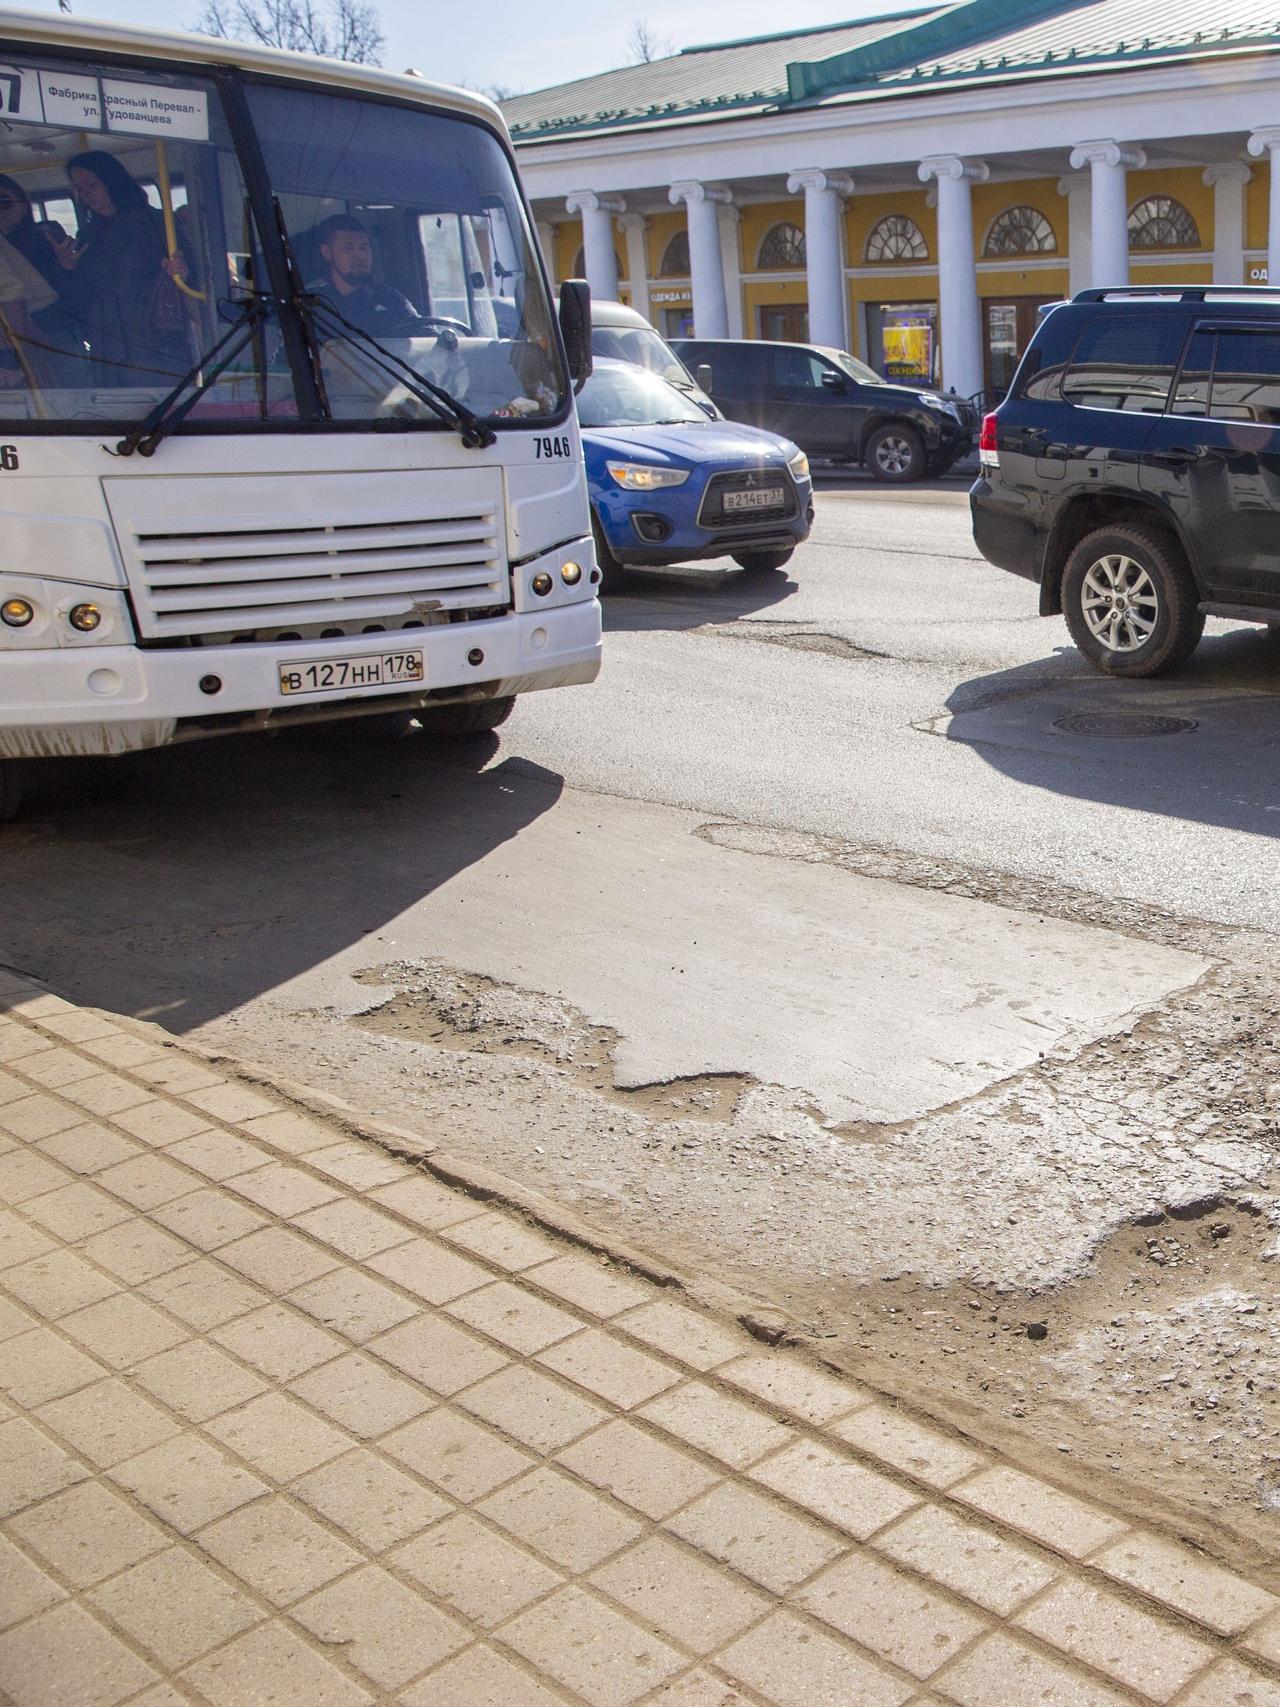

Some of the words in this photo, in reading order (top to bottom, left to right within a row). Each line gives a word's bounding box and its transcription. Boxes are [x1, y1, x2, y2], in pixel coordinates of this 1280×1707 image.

[0, 73, 21, 113] 7
[48, 86, 97, 101] Фабрика
[150, 99, 195, 113] Перевал
[533, 437, 571, 459] 7946
[288, 662, 380, 690] В127НН
[385, 655, 416, 673] 178
